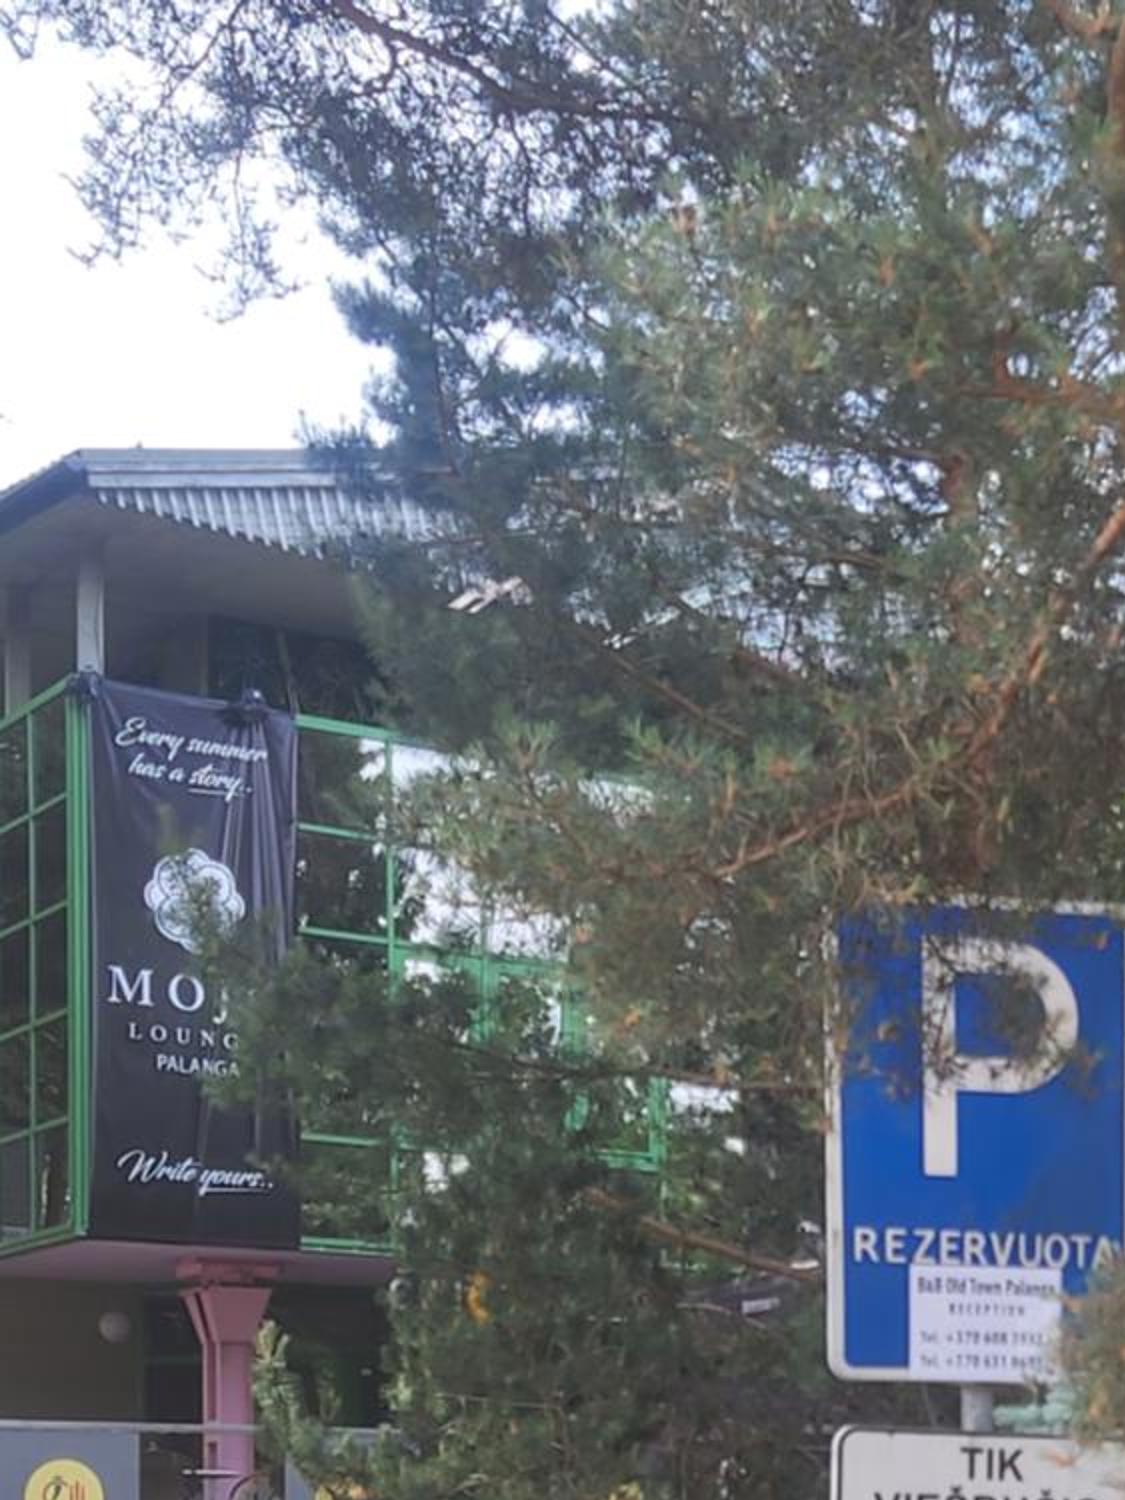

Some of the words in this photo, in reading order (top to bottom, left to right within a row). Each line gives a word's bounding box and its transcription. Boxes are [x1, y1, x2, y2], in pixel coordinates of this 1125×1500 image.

[114, 716, 184, 760] Every
[187, 737, 268, 762] summer
[128, 753, 163, 779] has
[168, 769, 185, 783] a
[108, 965, 229, 1025] MOJ
[128, 1021, 241, 1051] LOUNG
[156, 1053, 241, 1078] PALANGA
[921, 933, 1079, 1177] P
[116, 1150, 201, 1183] Write
[946, 1277, 966, 1295] Old
[970, 1277, 1002, 1295] Town
[960, 1446, 1023, 1481] TIK
